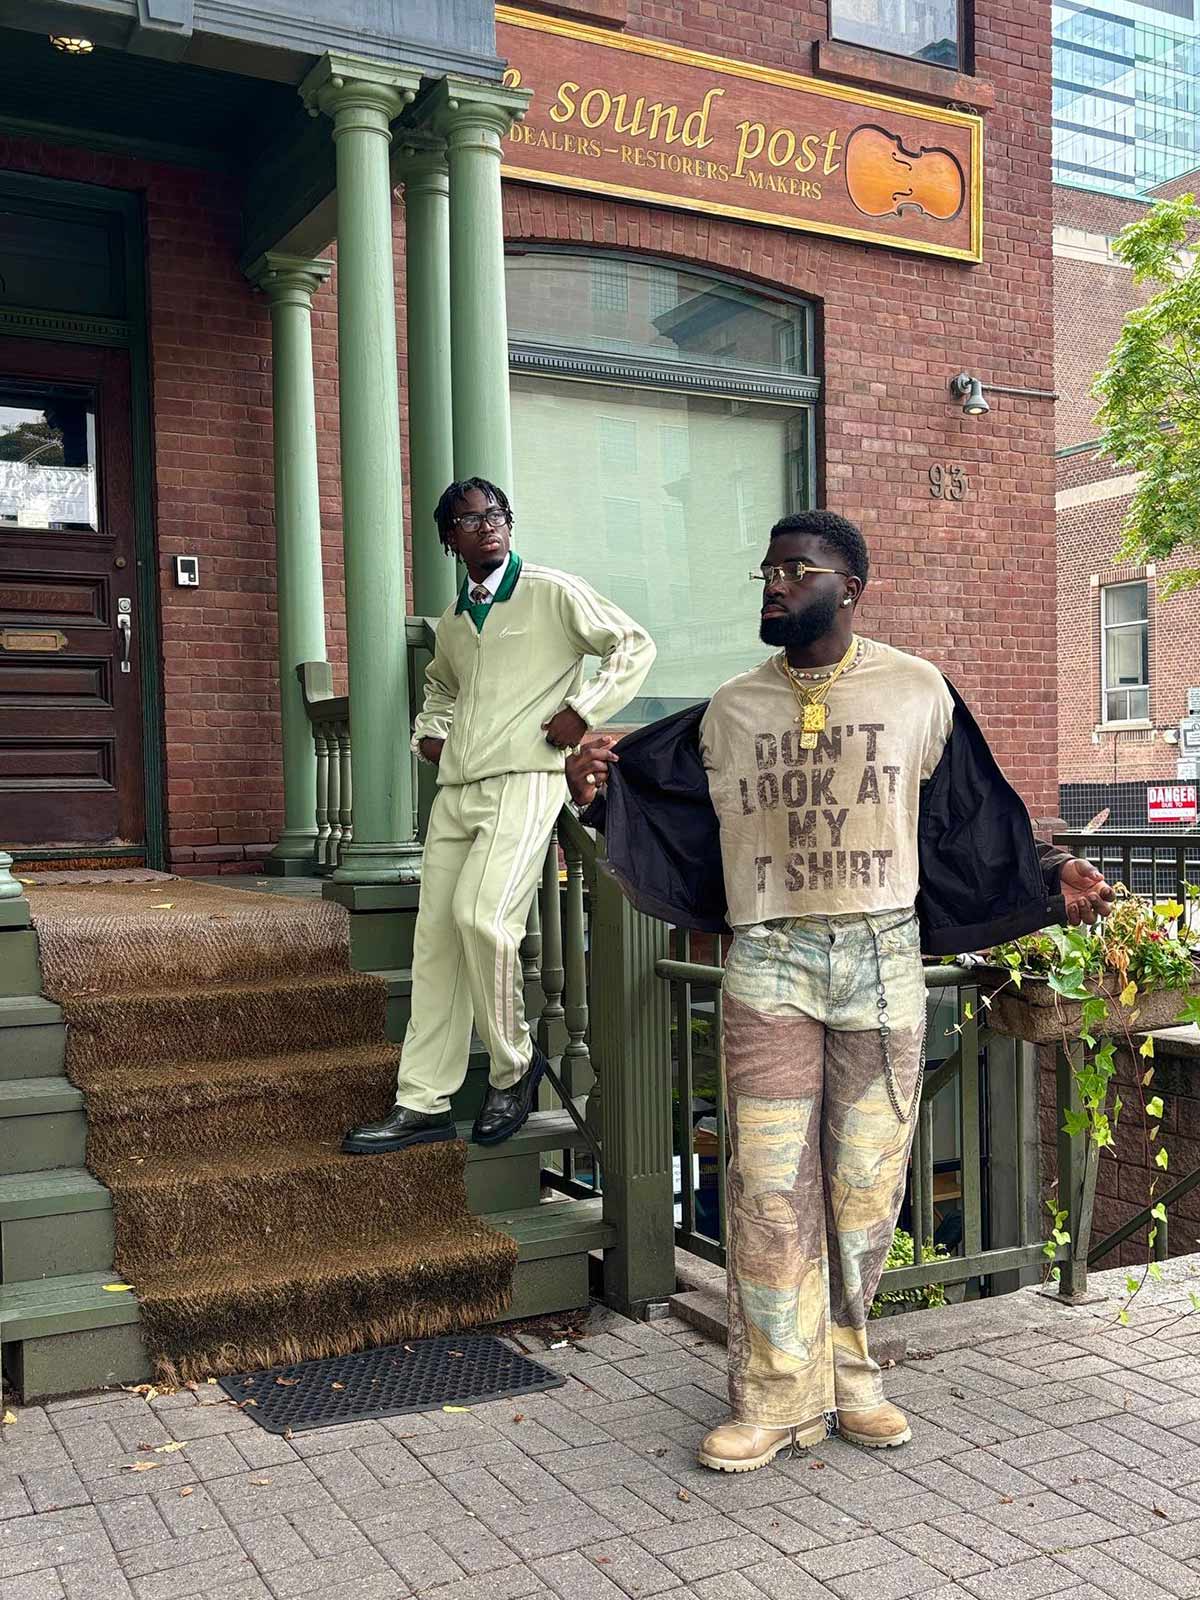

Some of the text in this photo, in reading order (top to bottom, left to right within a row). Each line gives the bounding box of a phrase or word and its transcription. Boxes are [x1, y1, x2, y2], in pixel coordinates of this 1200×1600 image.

[549, 81, 842, 178] sound post
[747, 169, 822, 200] MAKERS
[928, 462, 968, 501] 93
[754, 723, 885, 770] DON'T
[738, 765, 901, 816] LOOK AT
[1149, 786, 1195, 802] DANGER
[787, 807, 850, 849] MY
[754, 849, 893, 893] T SHIRT
